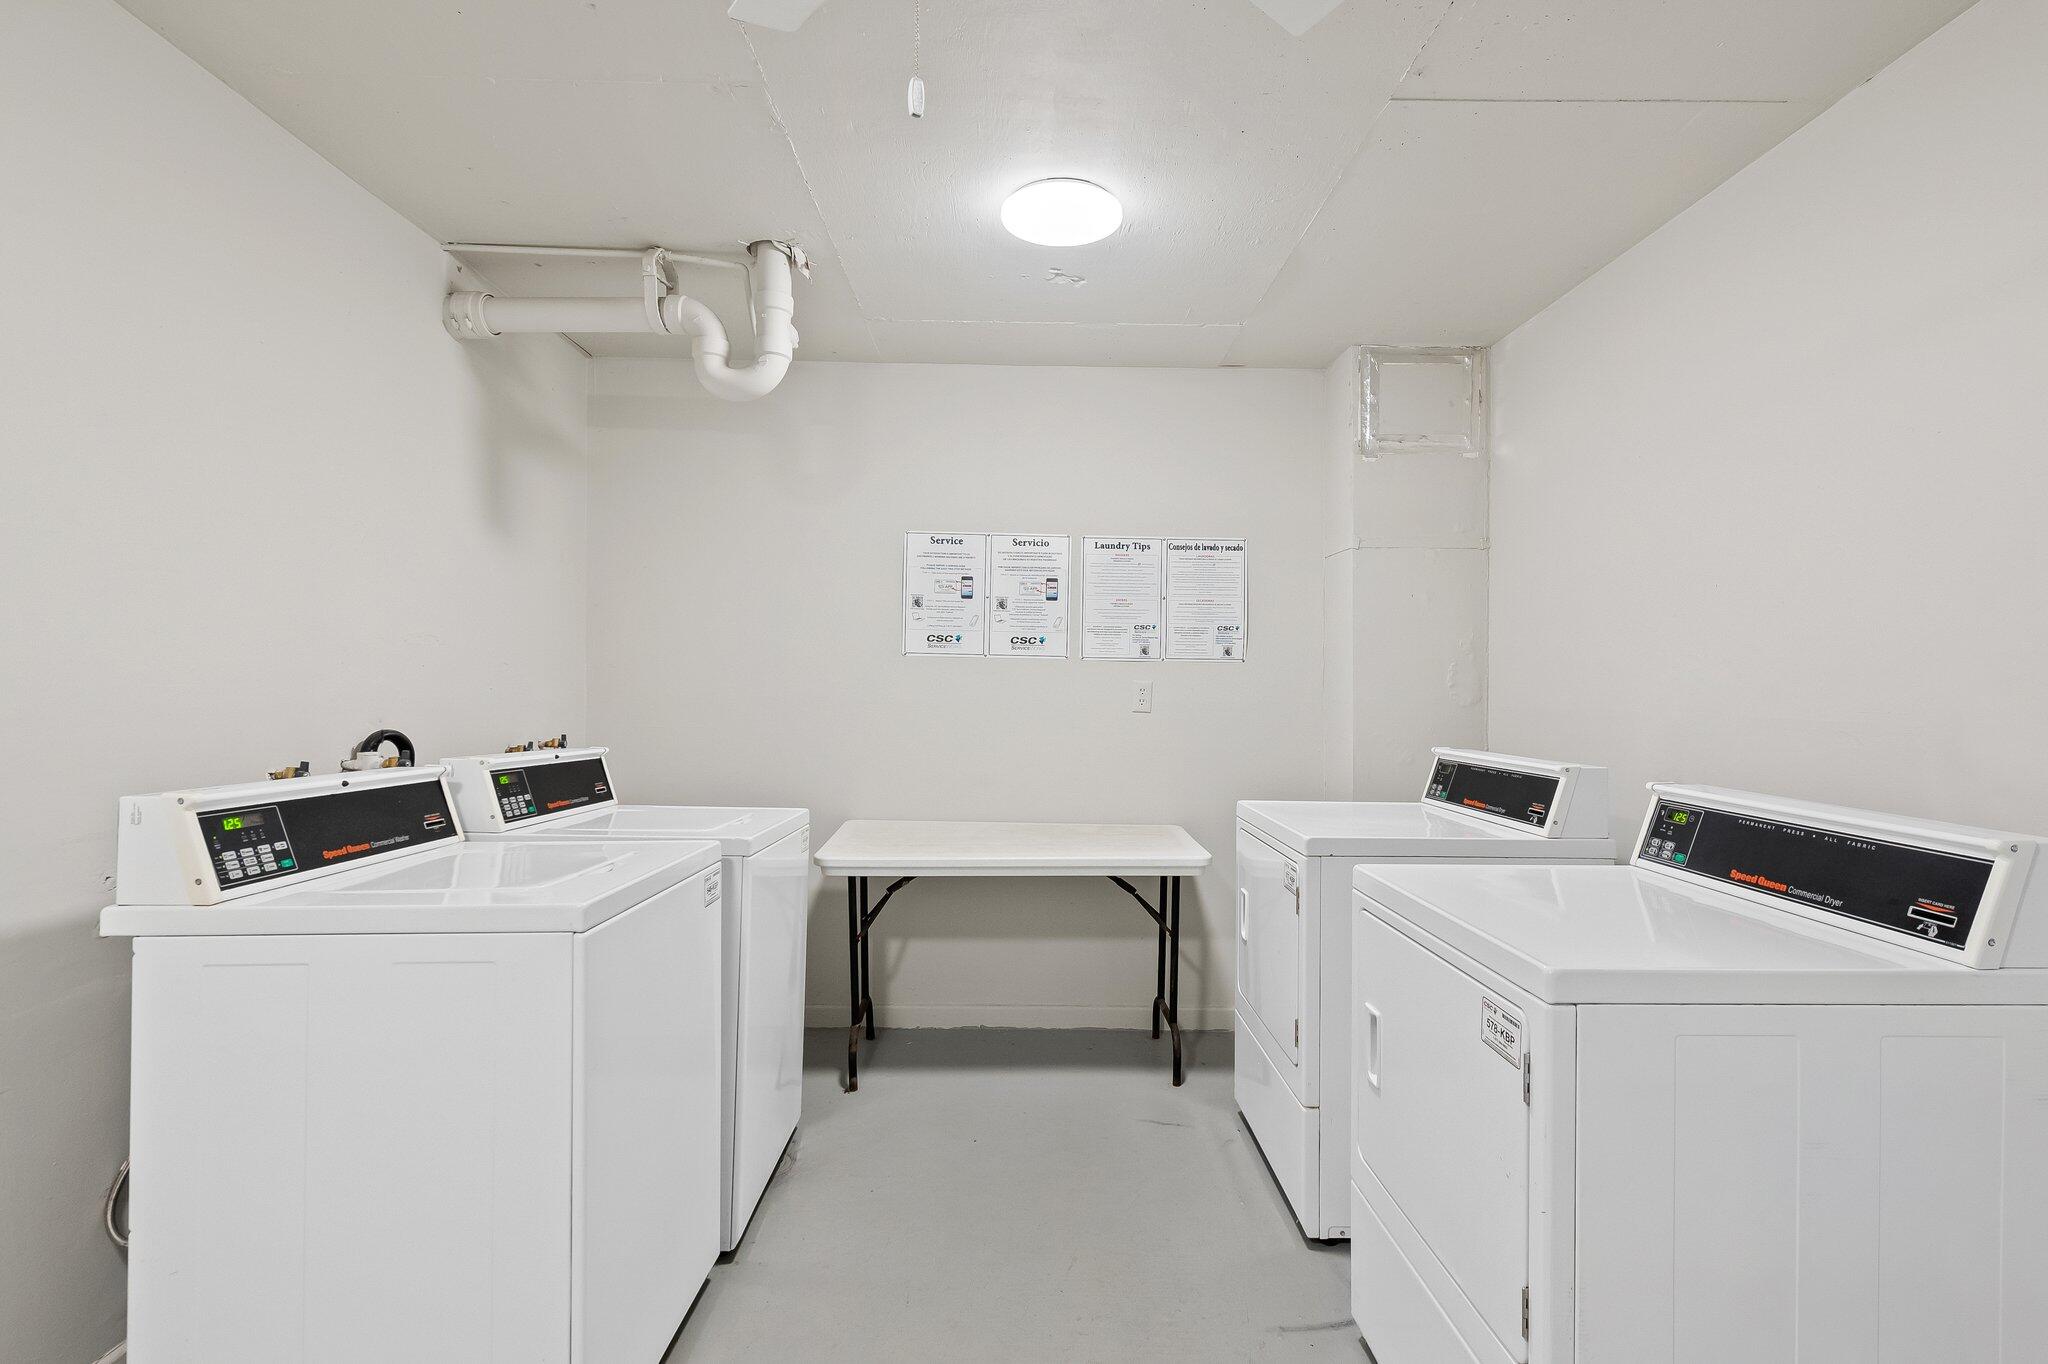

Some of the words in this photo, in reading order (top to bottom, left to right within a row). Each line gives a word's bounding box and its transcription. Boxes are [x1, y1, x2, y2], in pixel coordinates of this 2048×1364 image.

[930, 536, 964, 546] Service
[1012, 538, 1050, 548] Servicio
[1094, 541, 1131, 552] Laundry
[1132, 541, 1151, 552] Tips
[1168, 542, 1194, 553] Consejos
[1194, 543, 1201, 551] de
[1201, 543, 1220, 551] lavado
[1220, 545, 1225, 553] y
[1225, 543, 1244, 552] secado
[926, 634, 954, 643] CSC
[1010, 636, 1037, 645] CSC
[1783, 827, 1805, 837] PRESS
[322, 846, 347, 860] Speed
[1730, 869, 1759, 884] Speed
[1758, 876, 1787, 892] Queen
[1787, 885, 1825, 902] Commercial
[1824, 895, 1843, 908] Dryer
